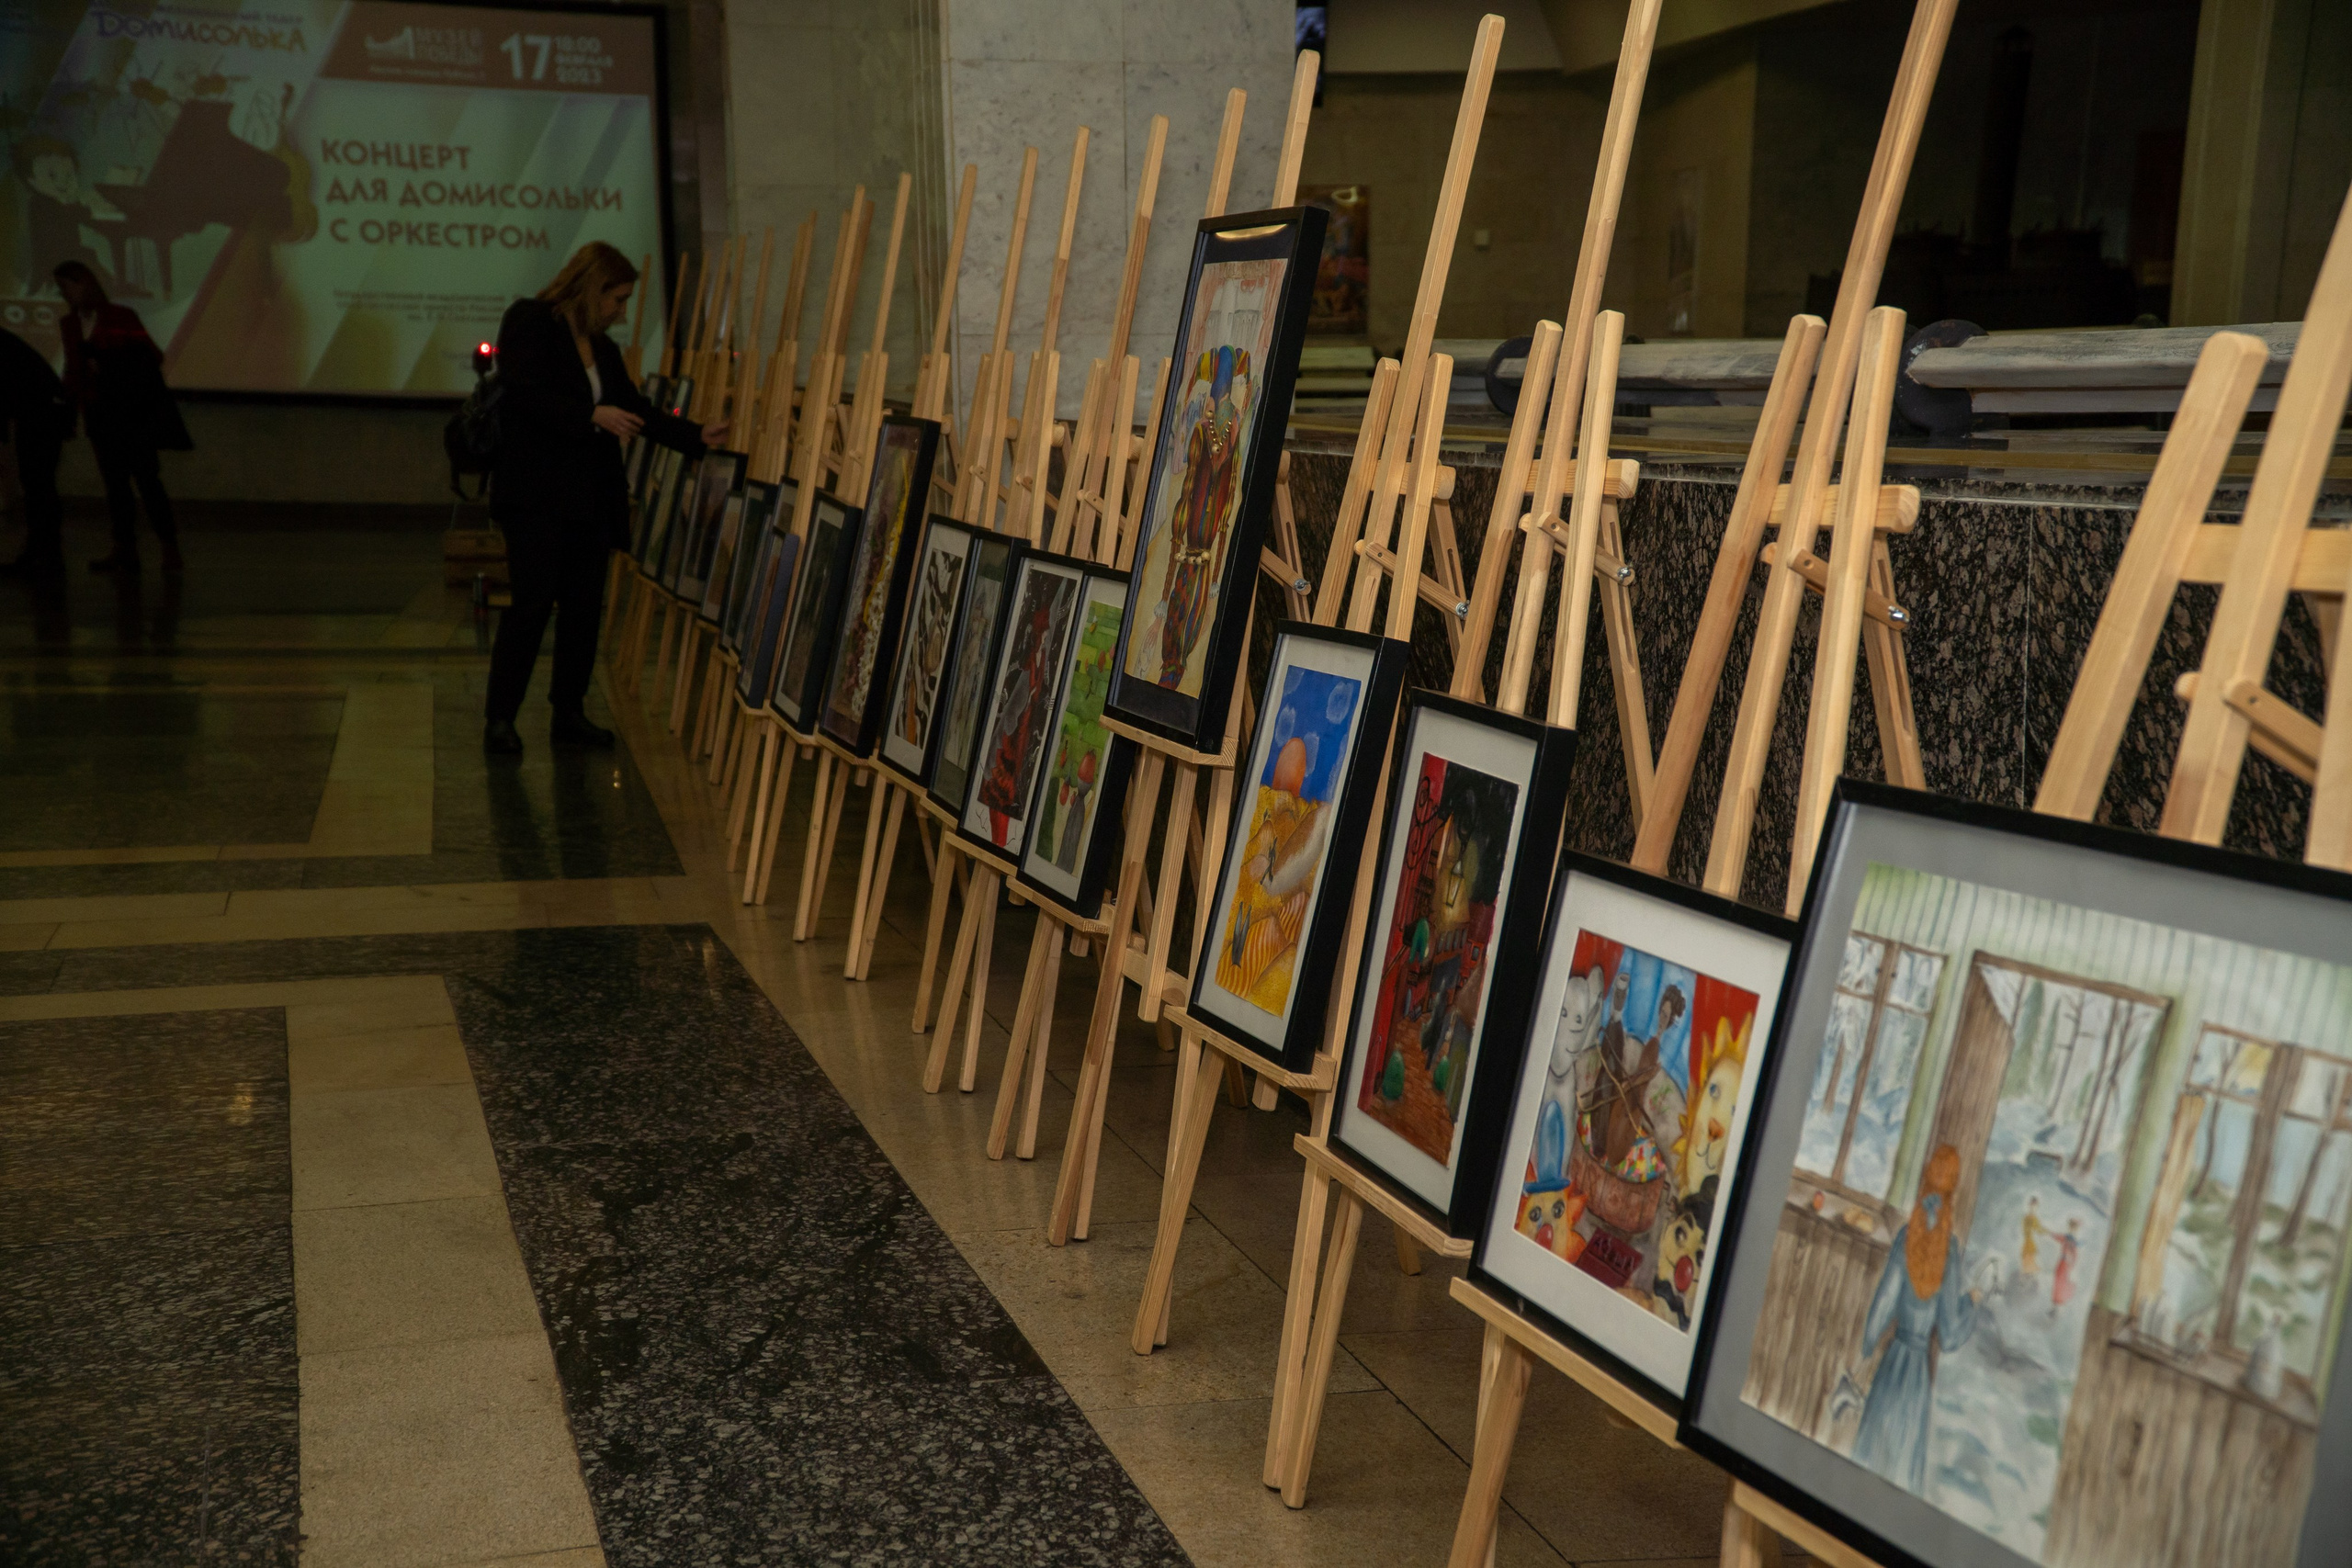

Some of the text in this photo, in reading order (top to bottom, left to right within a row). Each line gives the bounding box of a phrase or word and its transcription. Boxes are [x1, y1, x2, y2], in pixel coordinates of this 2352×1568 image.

[500, 32, 551, 81] 17
[322, 139, 470, 171] КОНЦЕРТ
[326, 177, 623, 211] ДЛЯ ДОМИСОЛЬКИ
[330, 218, 549, 250] С ОРКЕСТРОМ
